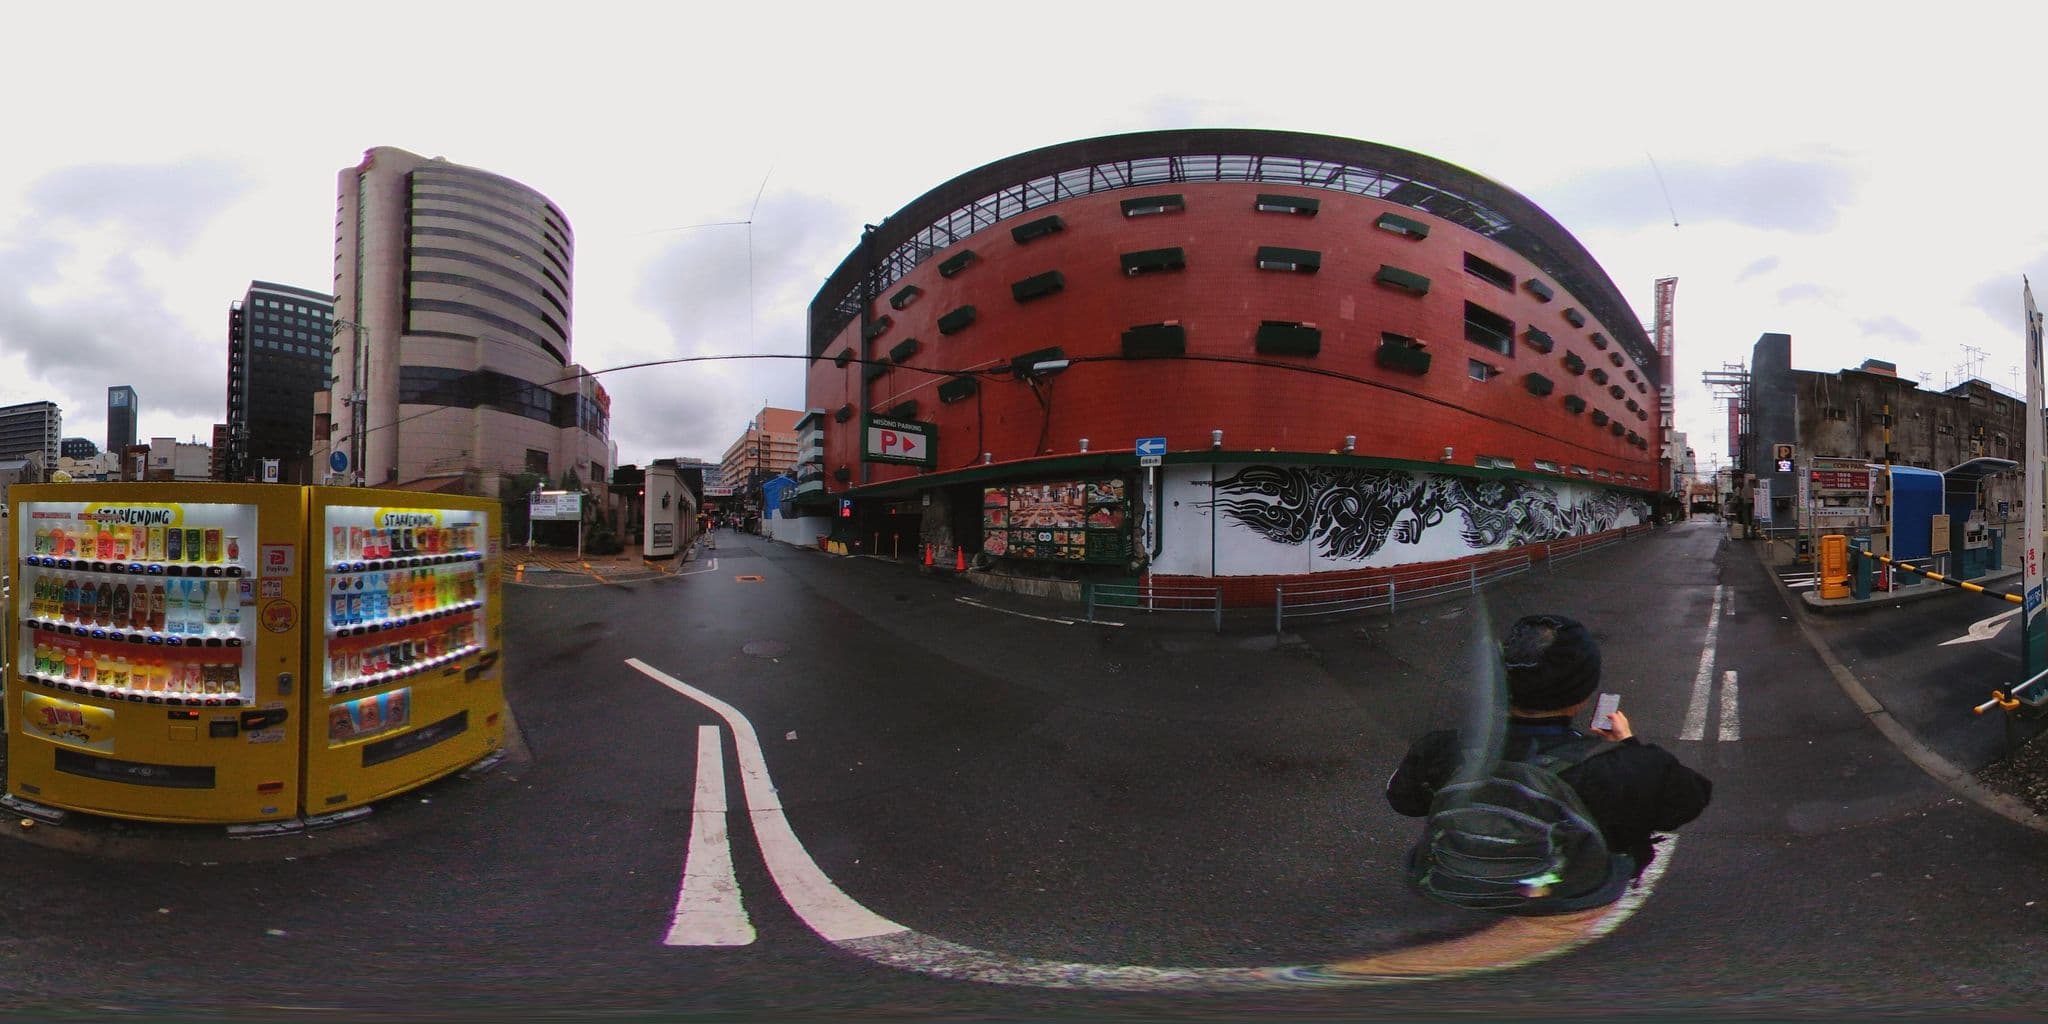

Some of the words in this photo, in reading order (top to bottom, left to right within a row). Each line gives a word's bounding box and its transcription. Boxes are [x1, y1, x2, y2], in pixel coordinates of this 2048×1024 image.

[873, 419, 896, 428] MISONO
[897, 421, 922, 431] PARKING
[881, 431, 897, 454] P
[1780, 447, 1790, 457] P
[843, 500, 851, 508] P
[266, 565, 289, 573] PayPay
